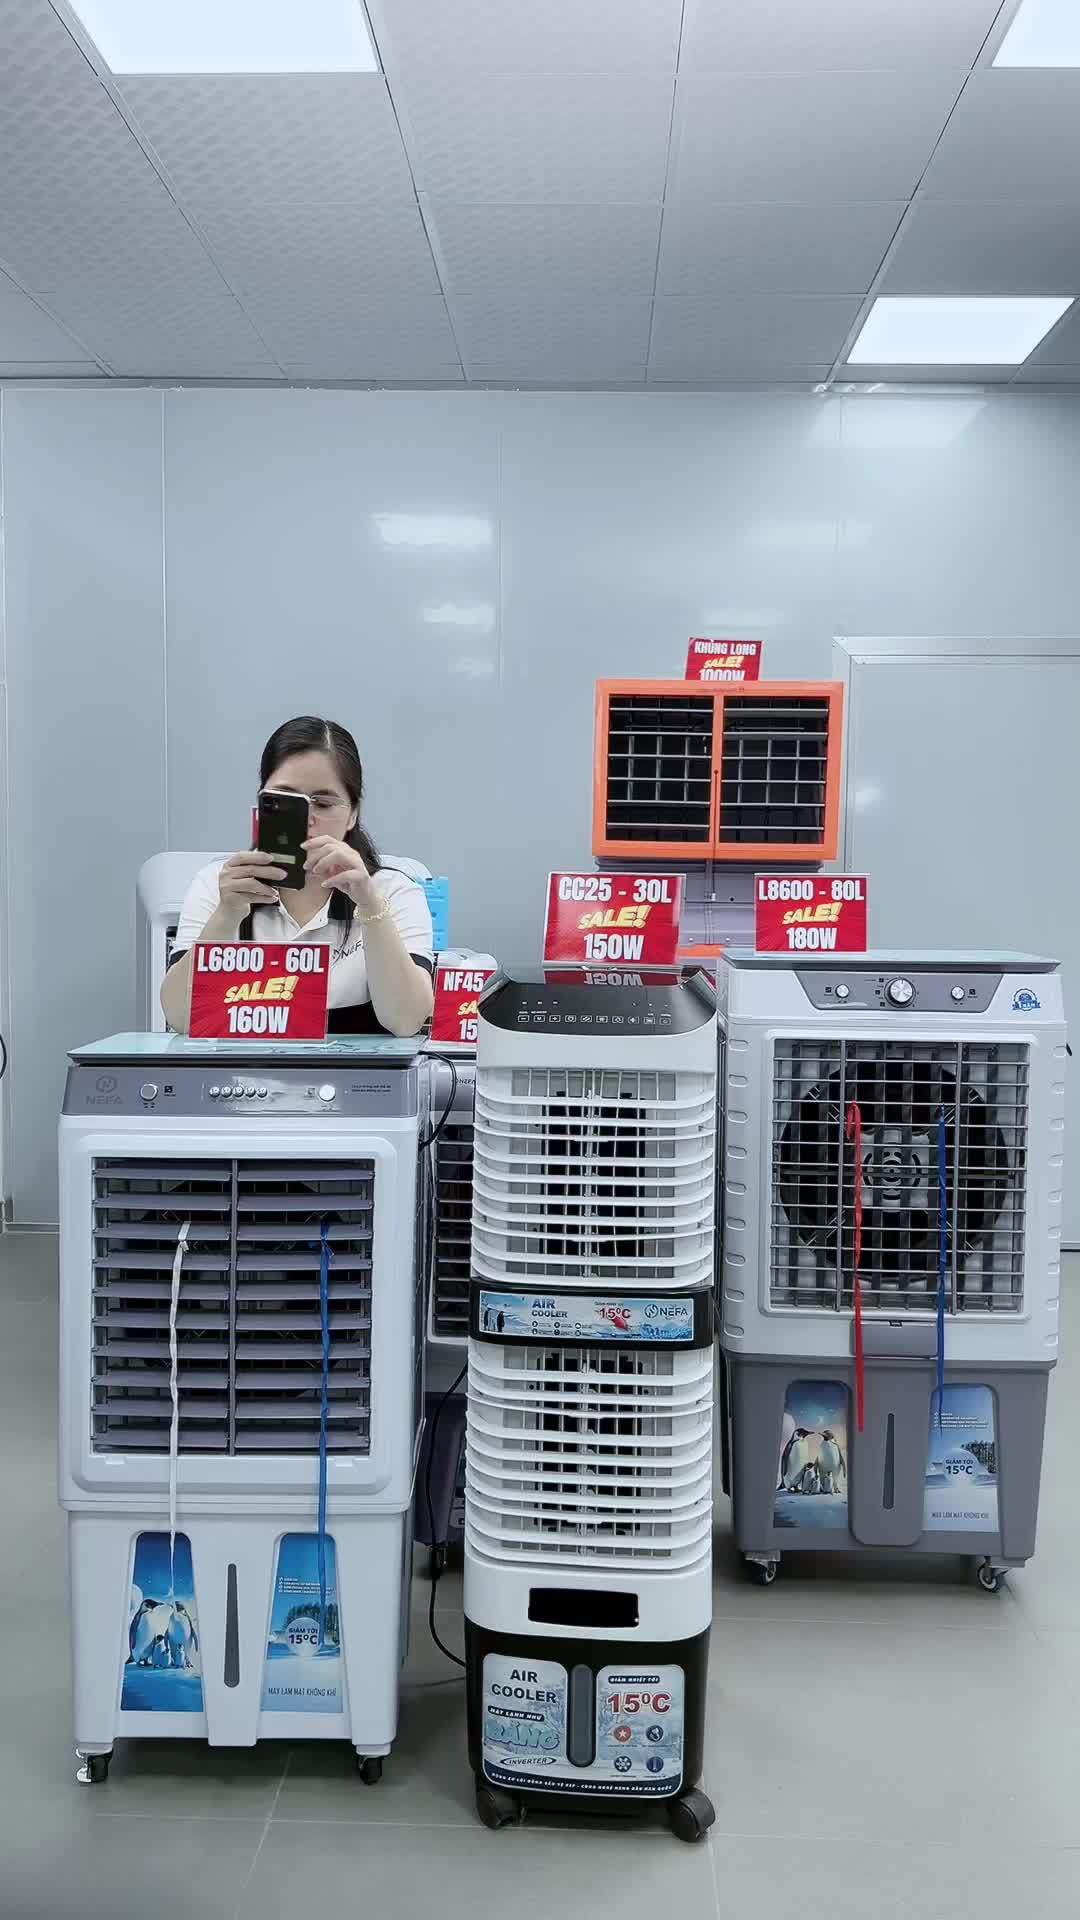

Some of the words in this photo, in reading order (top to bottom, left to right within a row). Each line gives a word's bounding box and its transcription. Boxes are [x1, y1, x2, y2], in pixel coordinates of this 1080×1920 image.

[730, 643, 757, 655] LONG
[703, 655, 744, 668] SALE!
[558, 876, 612, 901] CC25
[632, 879, 672, 903] 30L
[759, 880, 814, 900] L8600
[831, 880, 865, 900] 80L
[577, 905, 652, 929] SALE!
[781, 902, 843, 925] SALE!
[583, 934, 645, 960] 150W
[786, 927, 837, 949] 180W
[198, 946, 264, 972] L6800
[285, 947, 324, 972] 60L
[223, 975, 300, 1003] SALE!
[443, 971, 484, 992] NF45
[227, 1006, 290, 1034] 160W
[459, 1018, 477, 1040] 15
[86, 1095, 123, 1105] NEFA
[531, 1309, 568, 1318] COOLER
[532, 1299, 556, 1309] AIR
[660, 1307, 688, 1316] NEFA
[510, 1669, 538, 1683] AIR
[491, 1683, 557, 1704] COOLER
